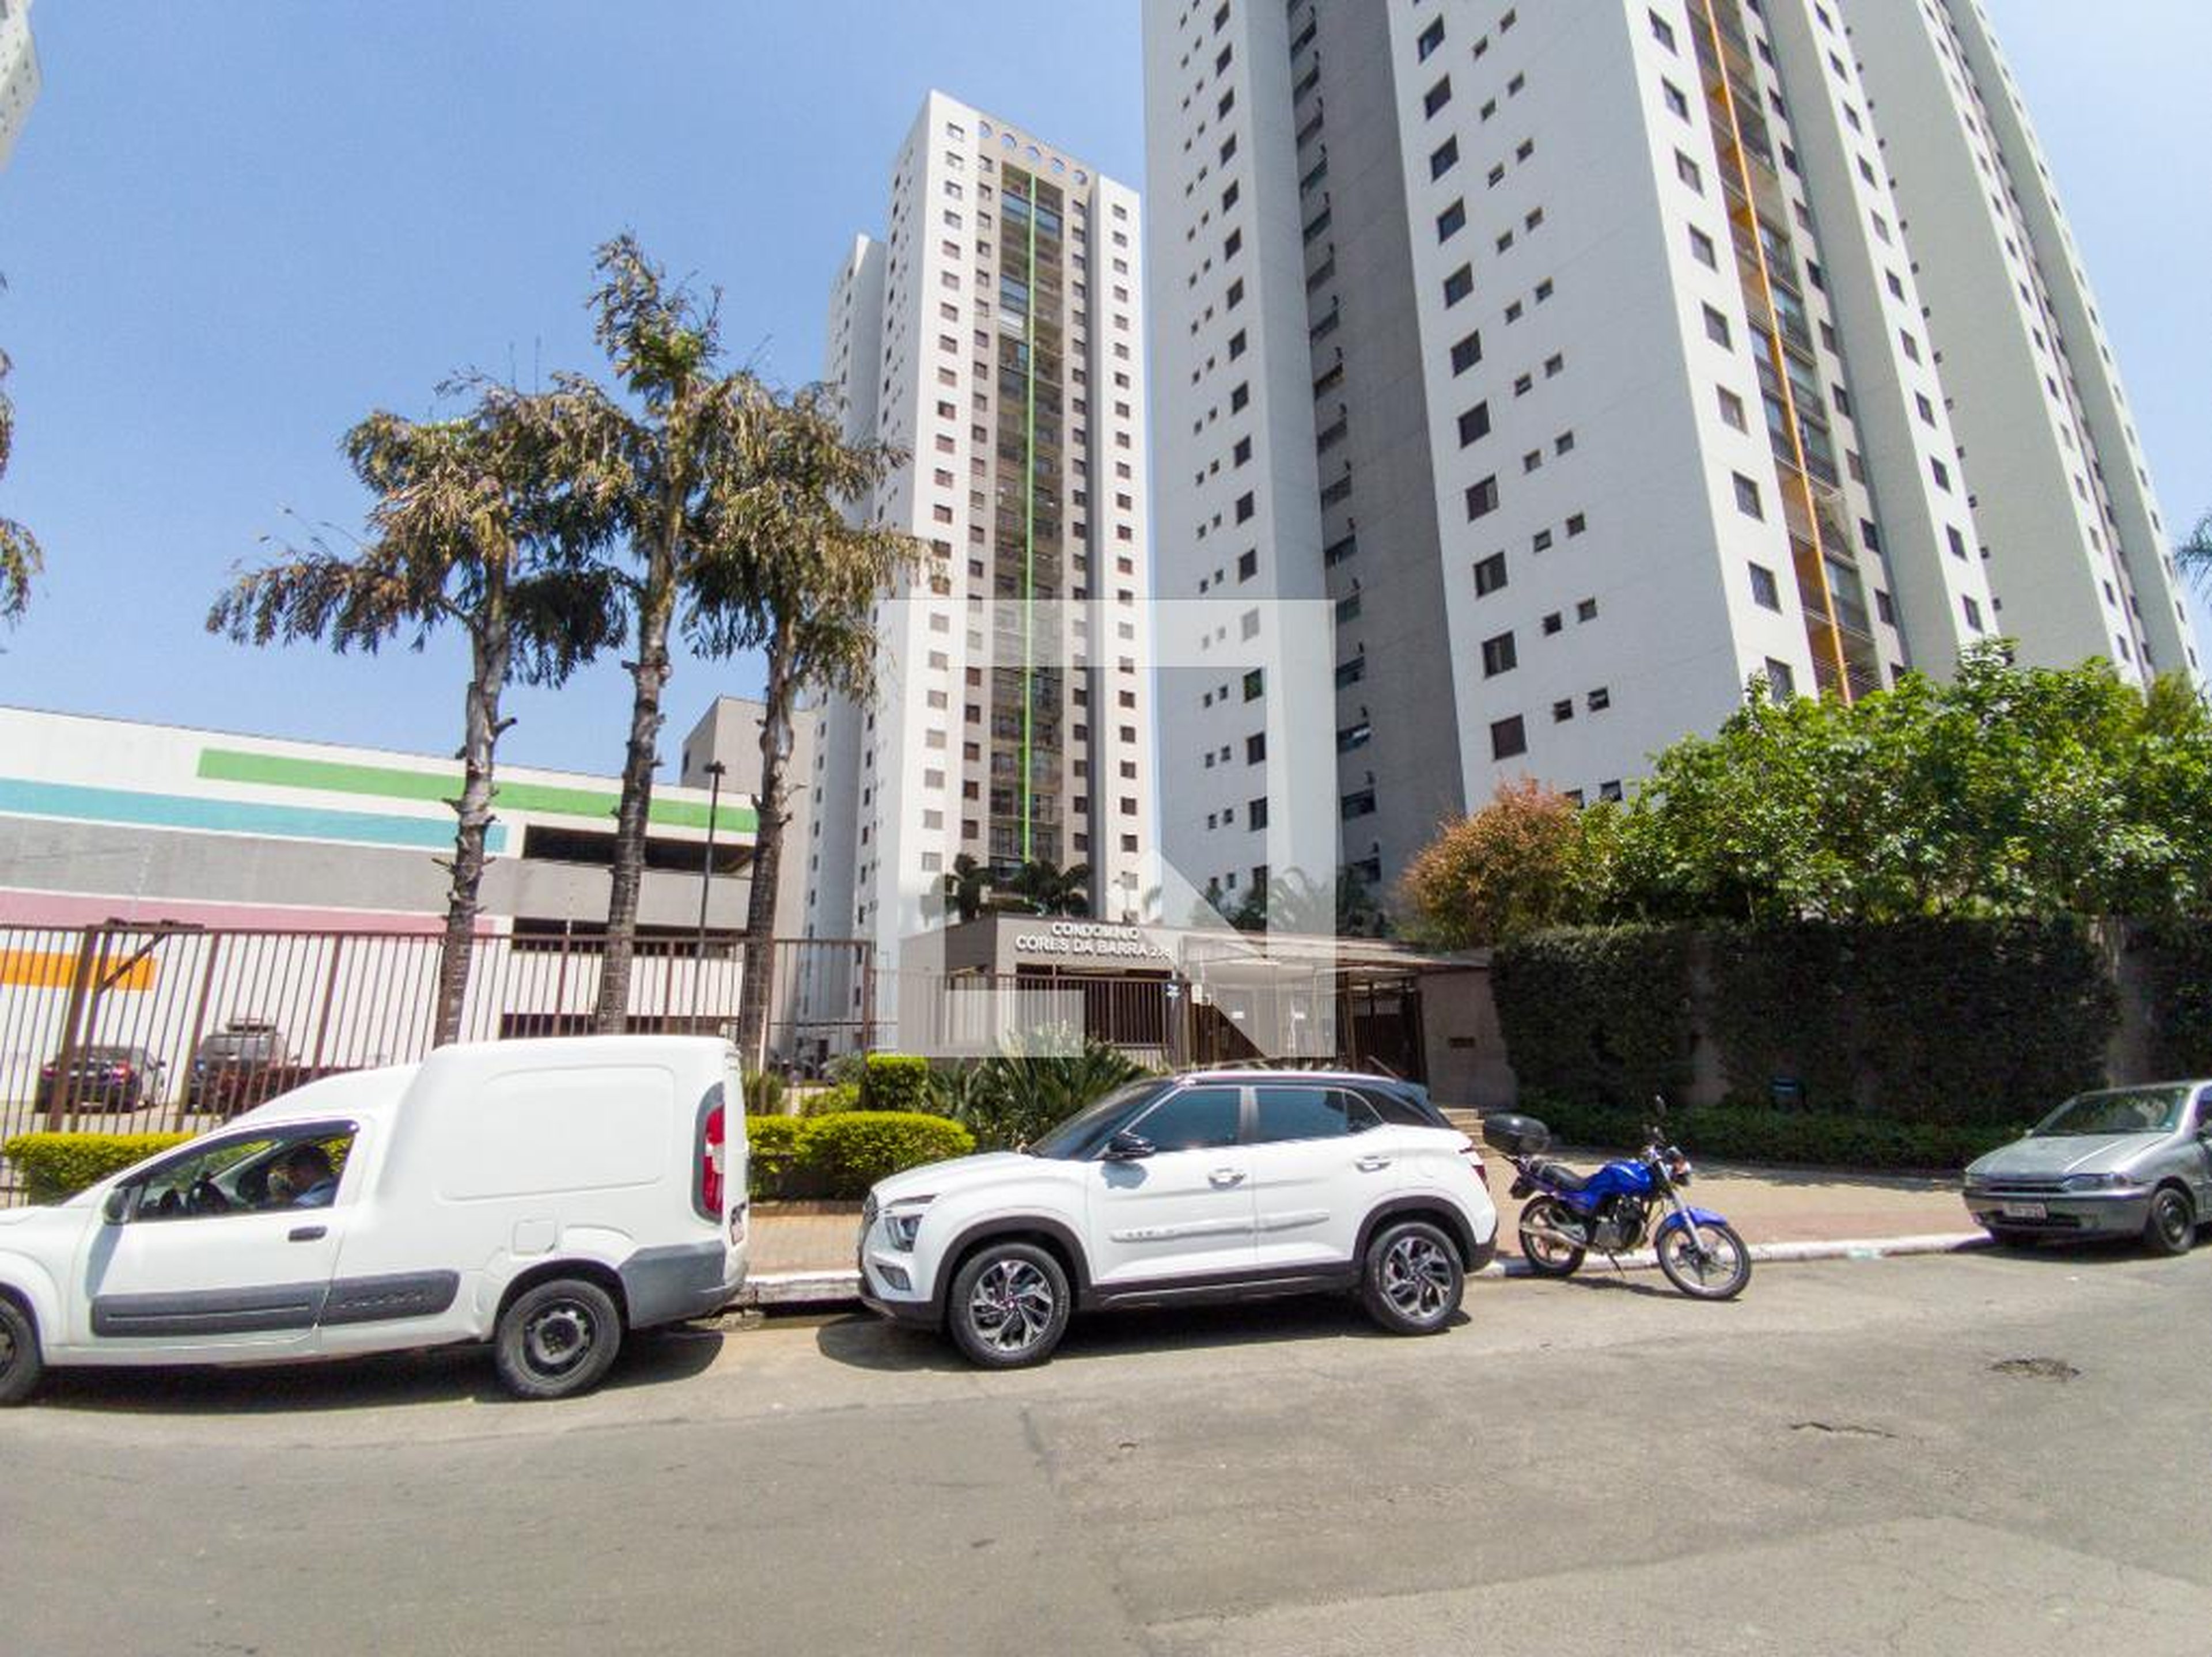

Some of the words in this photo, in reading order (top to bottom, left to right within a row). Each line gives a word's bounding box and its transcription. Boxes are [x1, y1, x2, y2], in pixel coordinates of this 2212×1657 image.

[1016, 935, 1069, 951] CORES
[1074, 939, 1093, 952] DA
[1097, 941, 1148, 955] BARRA
